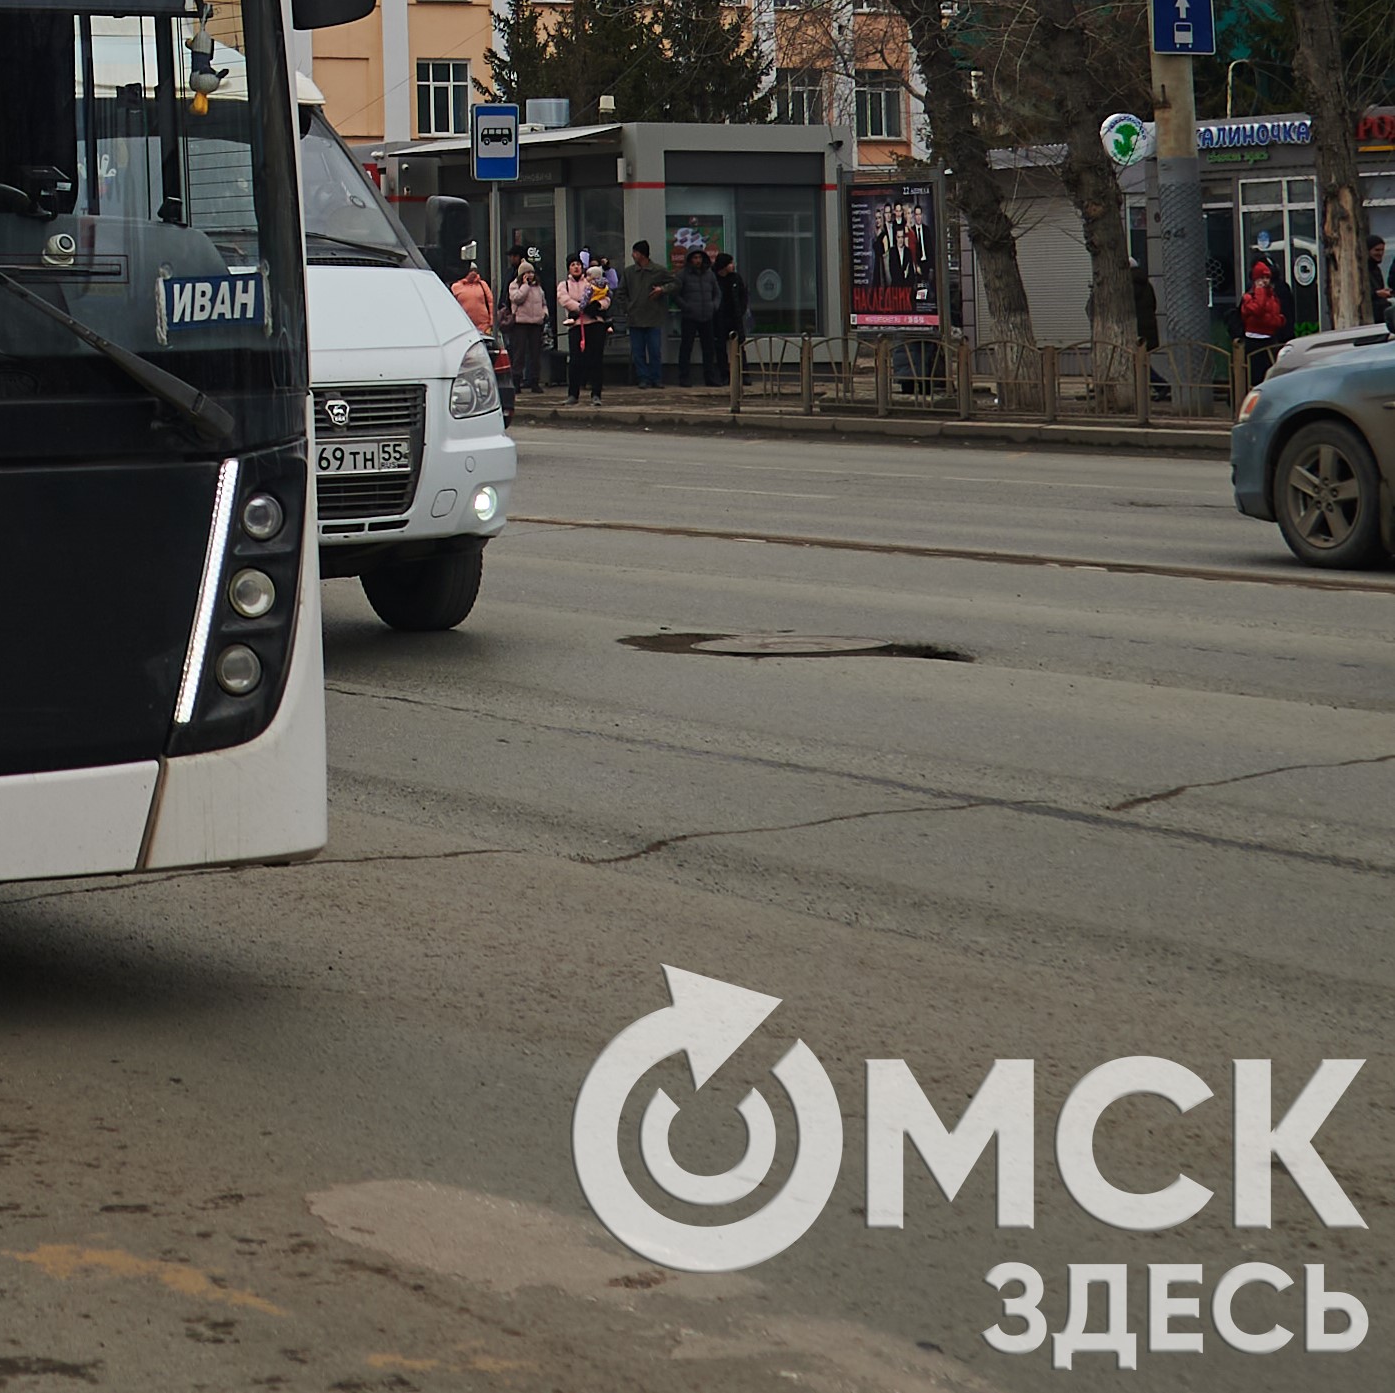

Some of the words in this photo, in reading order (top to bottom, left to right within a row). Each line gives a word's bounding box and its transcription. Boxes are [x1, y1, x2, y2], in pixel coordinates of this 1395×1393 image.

[172, 280, 256, 323] ИВАН
[853, 287, 912, 312] НАСЛЕДНИК
[317, 446, 376, 471] 69ТН
[381, 443, 403, 462] 55
